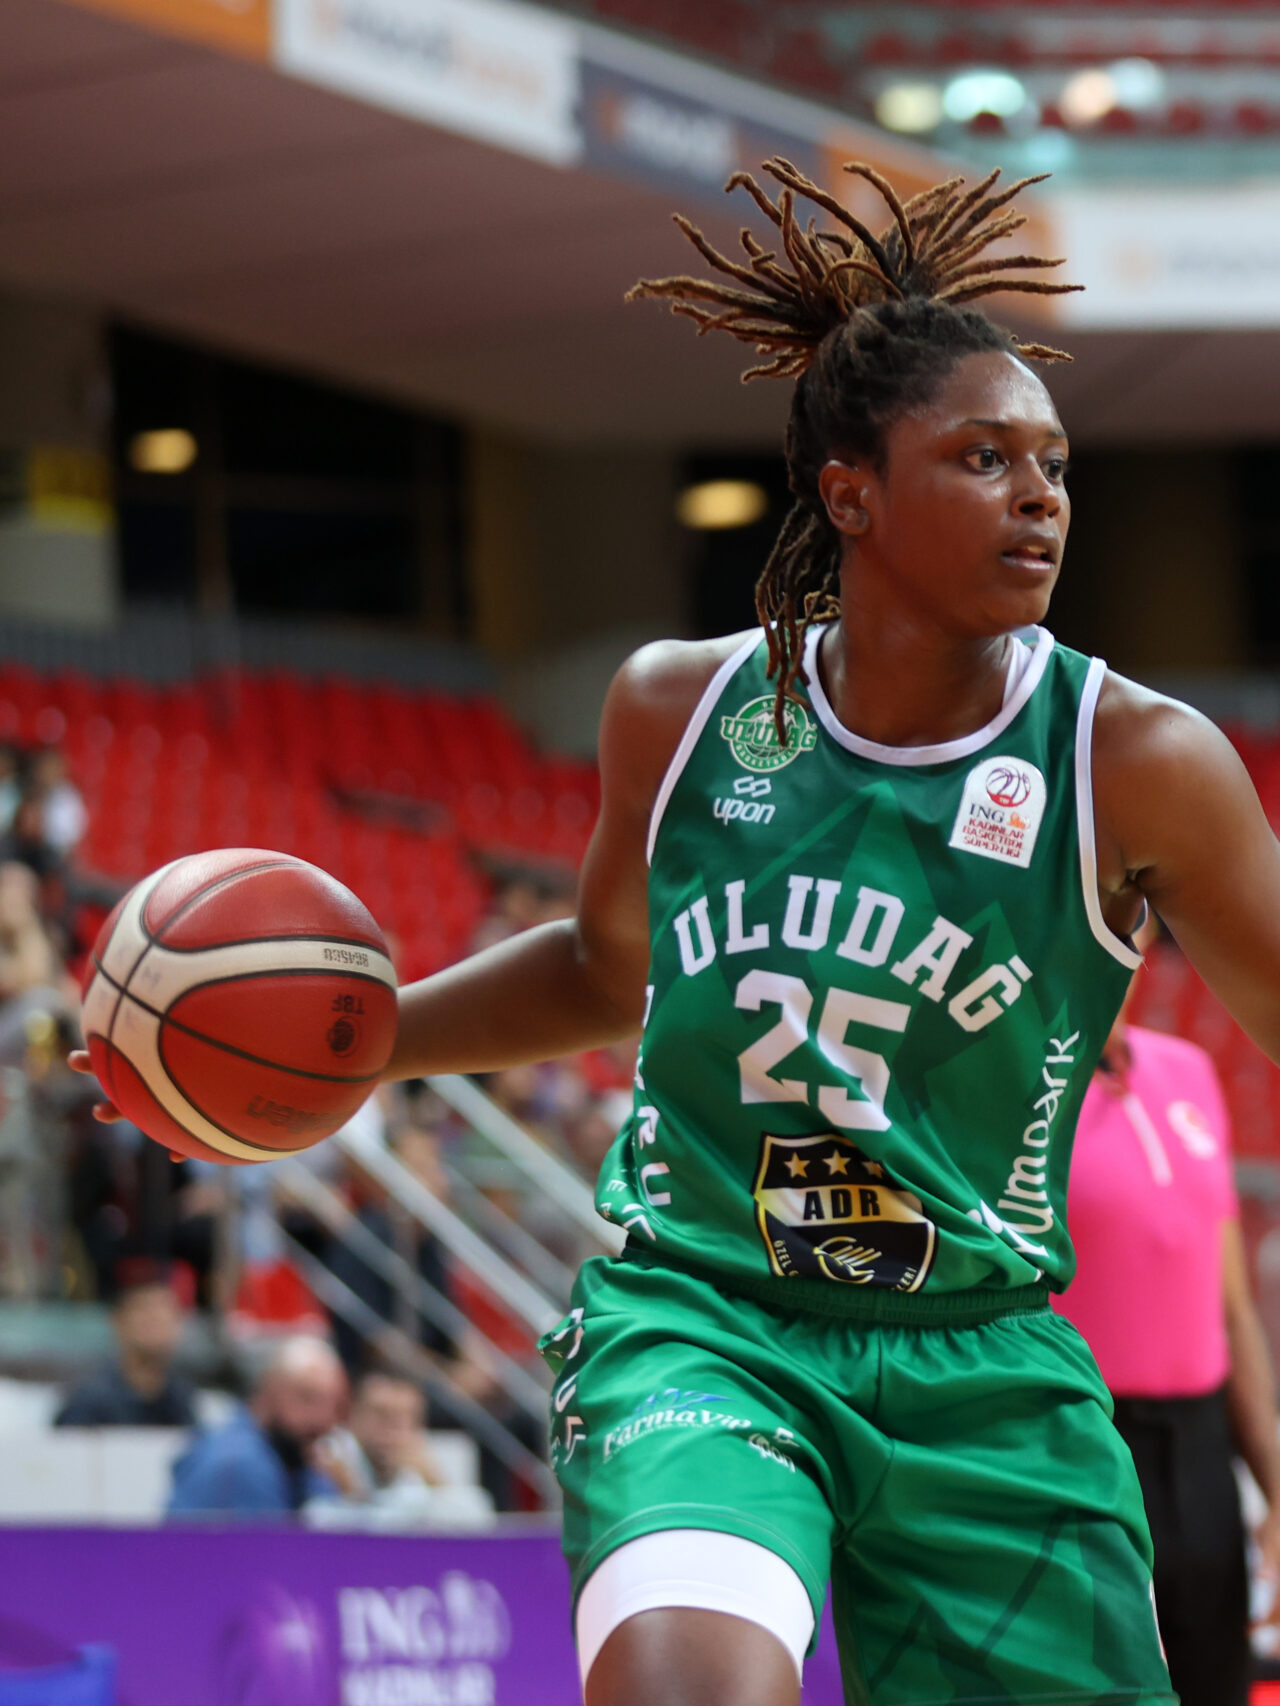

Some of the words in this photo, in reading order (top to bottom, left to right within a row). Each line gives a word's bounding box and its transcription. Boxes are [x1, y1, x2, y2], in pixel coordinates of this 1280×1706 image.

[713, 797, 776, 826] upon
[969, 802, 1005, 823] ING
[673, 873, 1033, 1032] ULUDAĞ
[331, 993, 366, 1015] TBF
[734, 968, 911, 1132] 25
[803, 1188, 881, 1221] ADR
[773, 1239, 793, 1269] ÖZEL
[603, 1409, 752, 1458] FarmaVip
